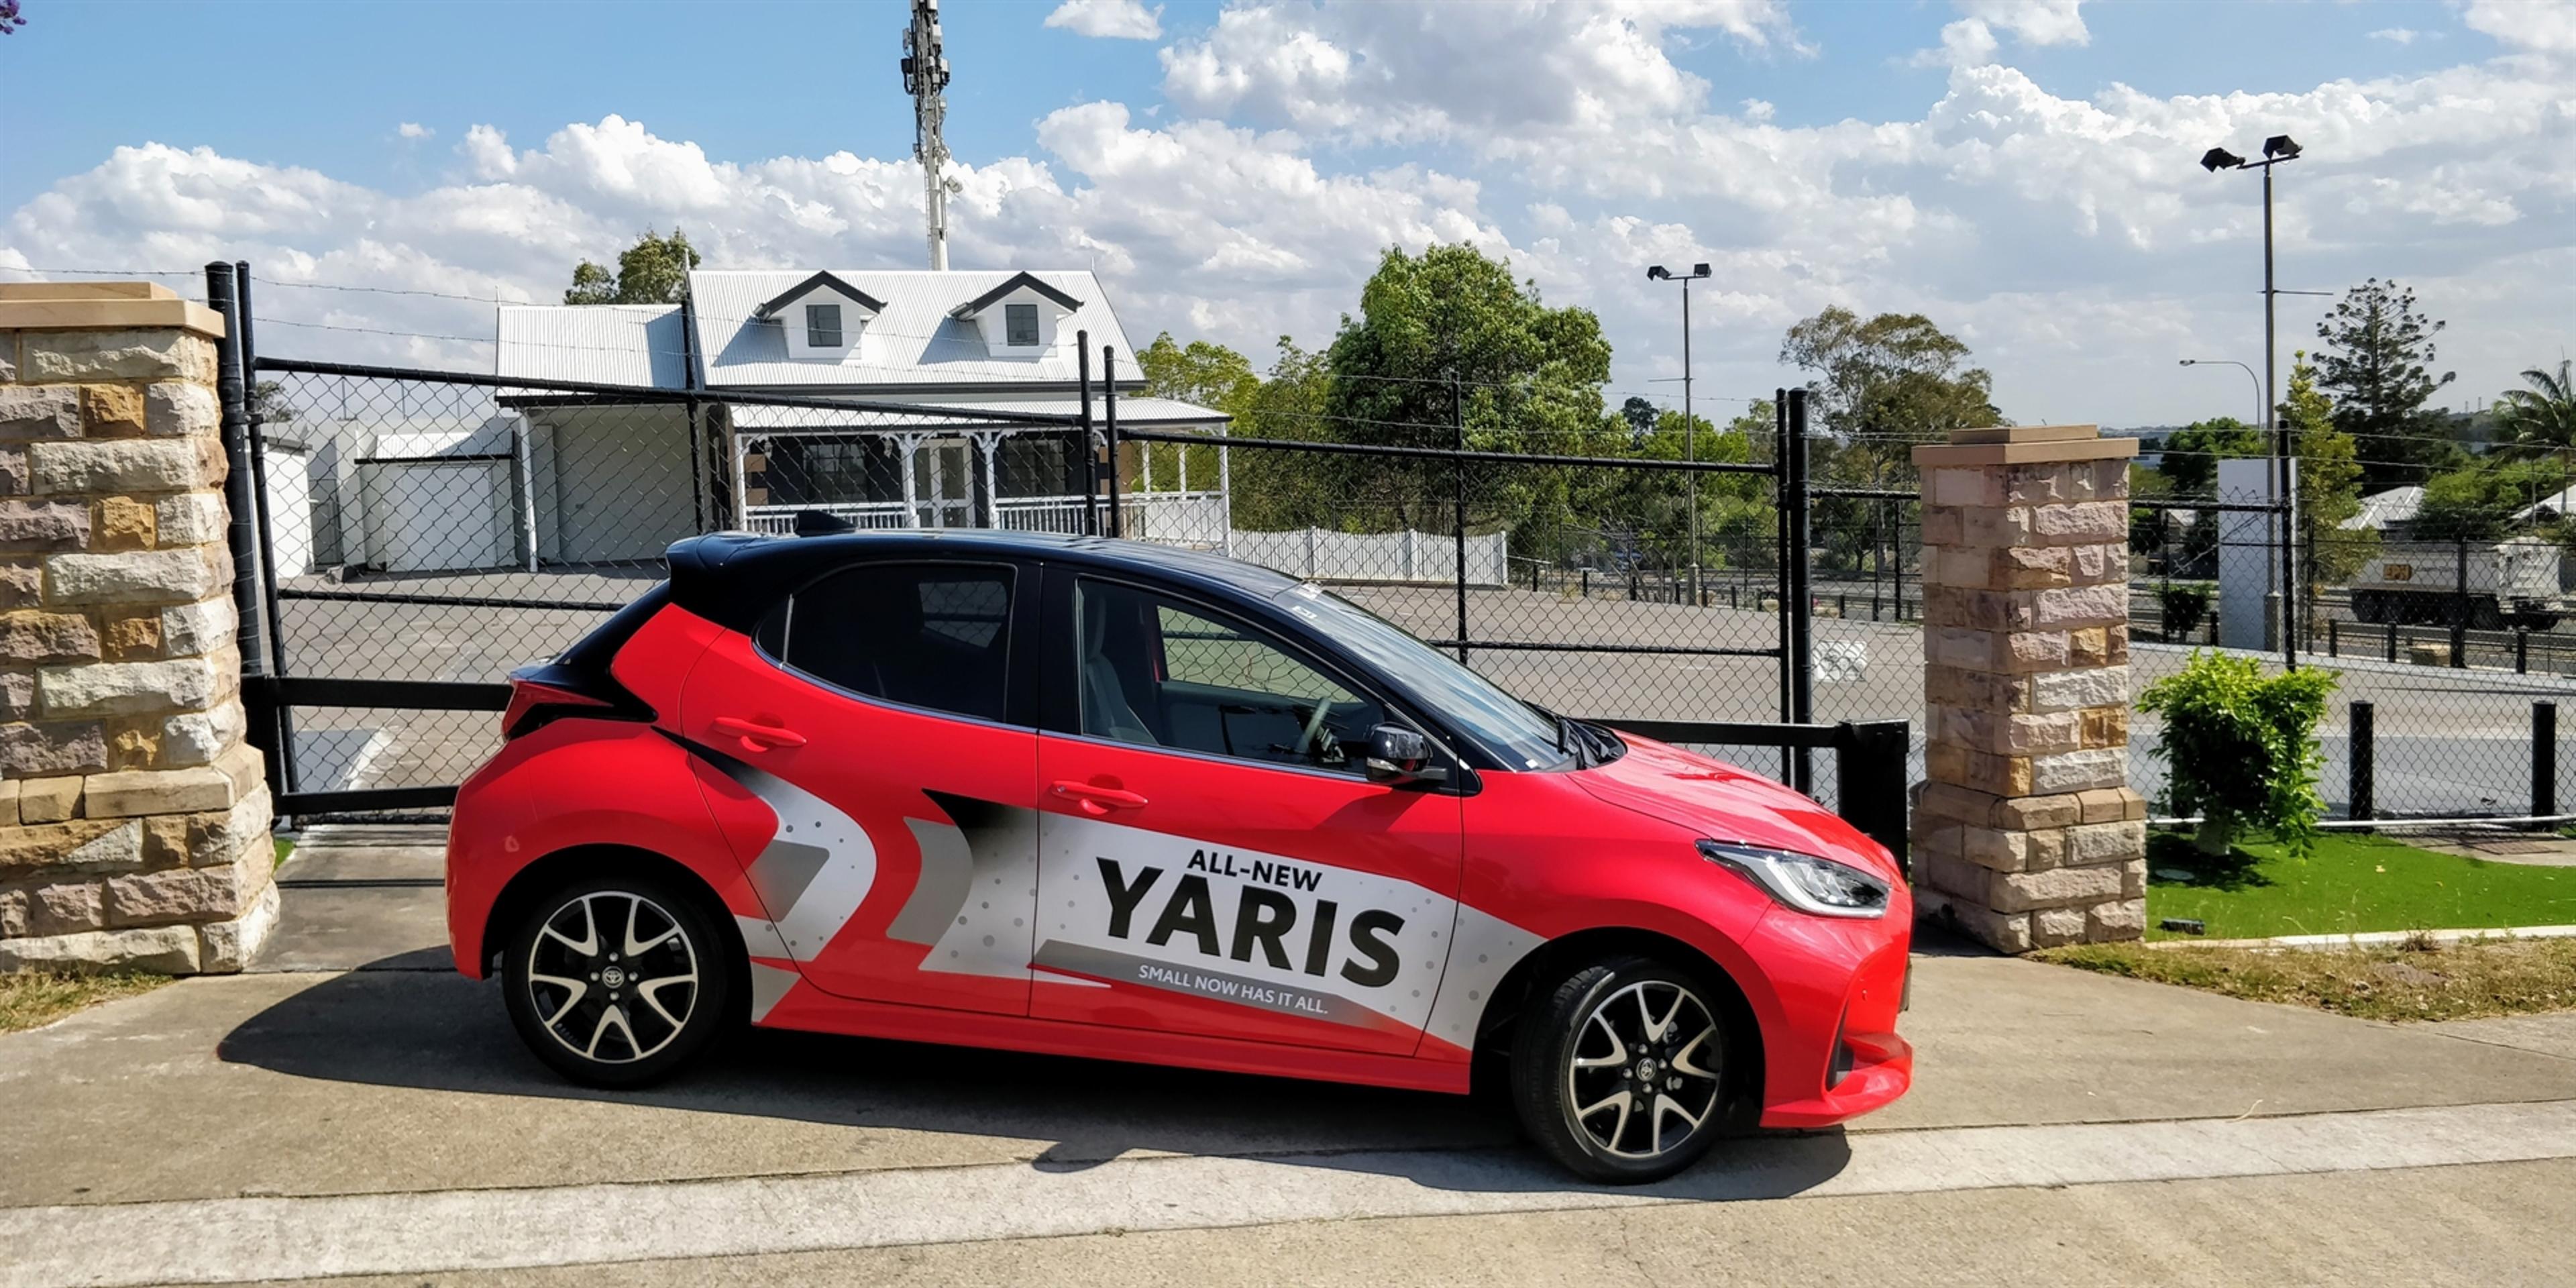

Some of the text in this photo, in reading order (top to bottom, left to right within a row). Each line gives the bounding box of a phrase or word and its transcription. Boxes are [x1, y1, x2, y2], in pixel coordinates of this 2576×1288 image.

[1187, 849, 1322, 892] ALL-NEW
[1096, 857, 1405, 987] YARIS
[1138, 965, 1328, 1014] SMALL NOW HAS IT ALL.
